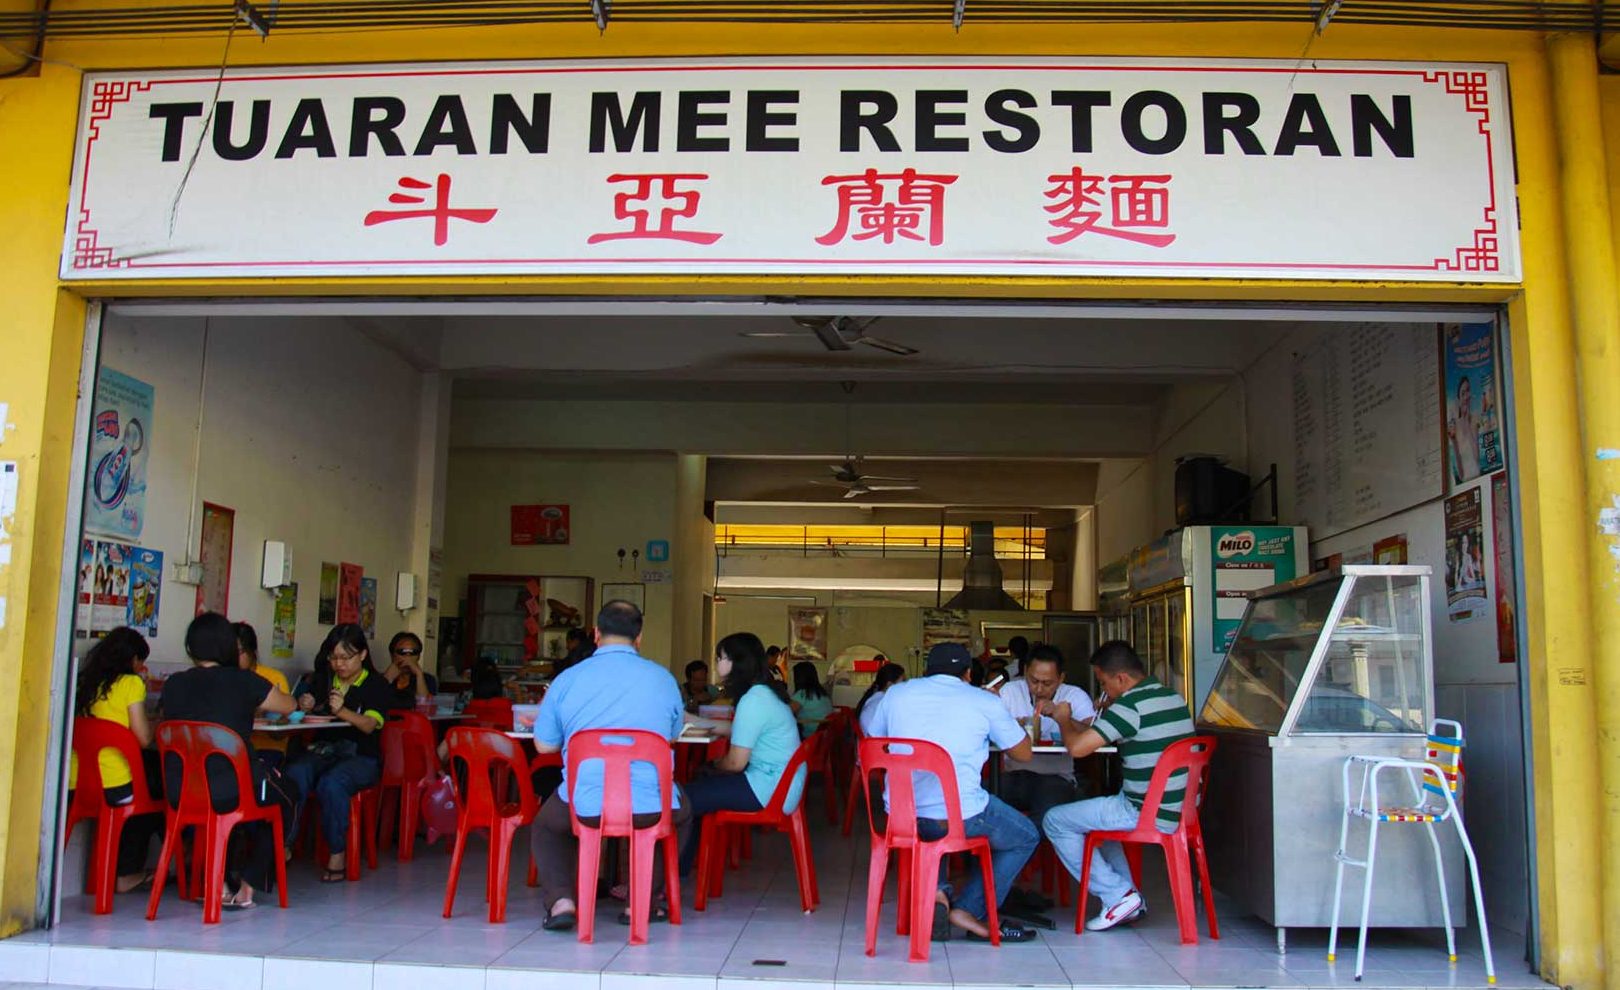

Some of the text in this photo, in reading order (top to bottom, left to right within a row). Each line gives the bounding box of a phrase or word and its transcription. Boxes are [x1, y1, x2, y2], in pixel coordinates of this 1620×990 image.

[149, 89, 1416, 162] TUARAN MEE RESTORAN
[364, 166, 1176, 246] 斗亞蘭麵
[1220, 540, 1251, 551] MILO
